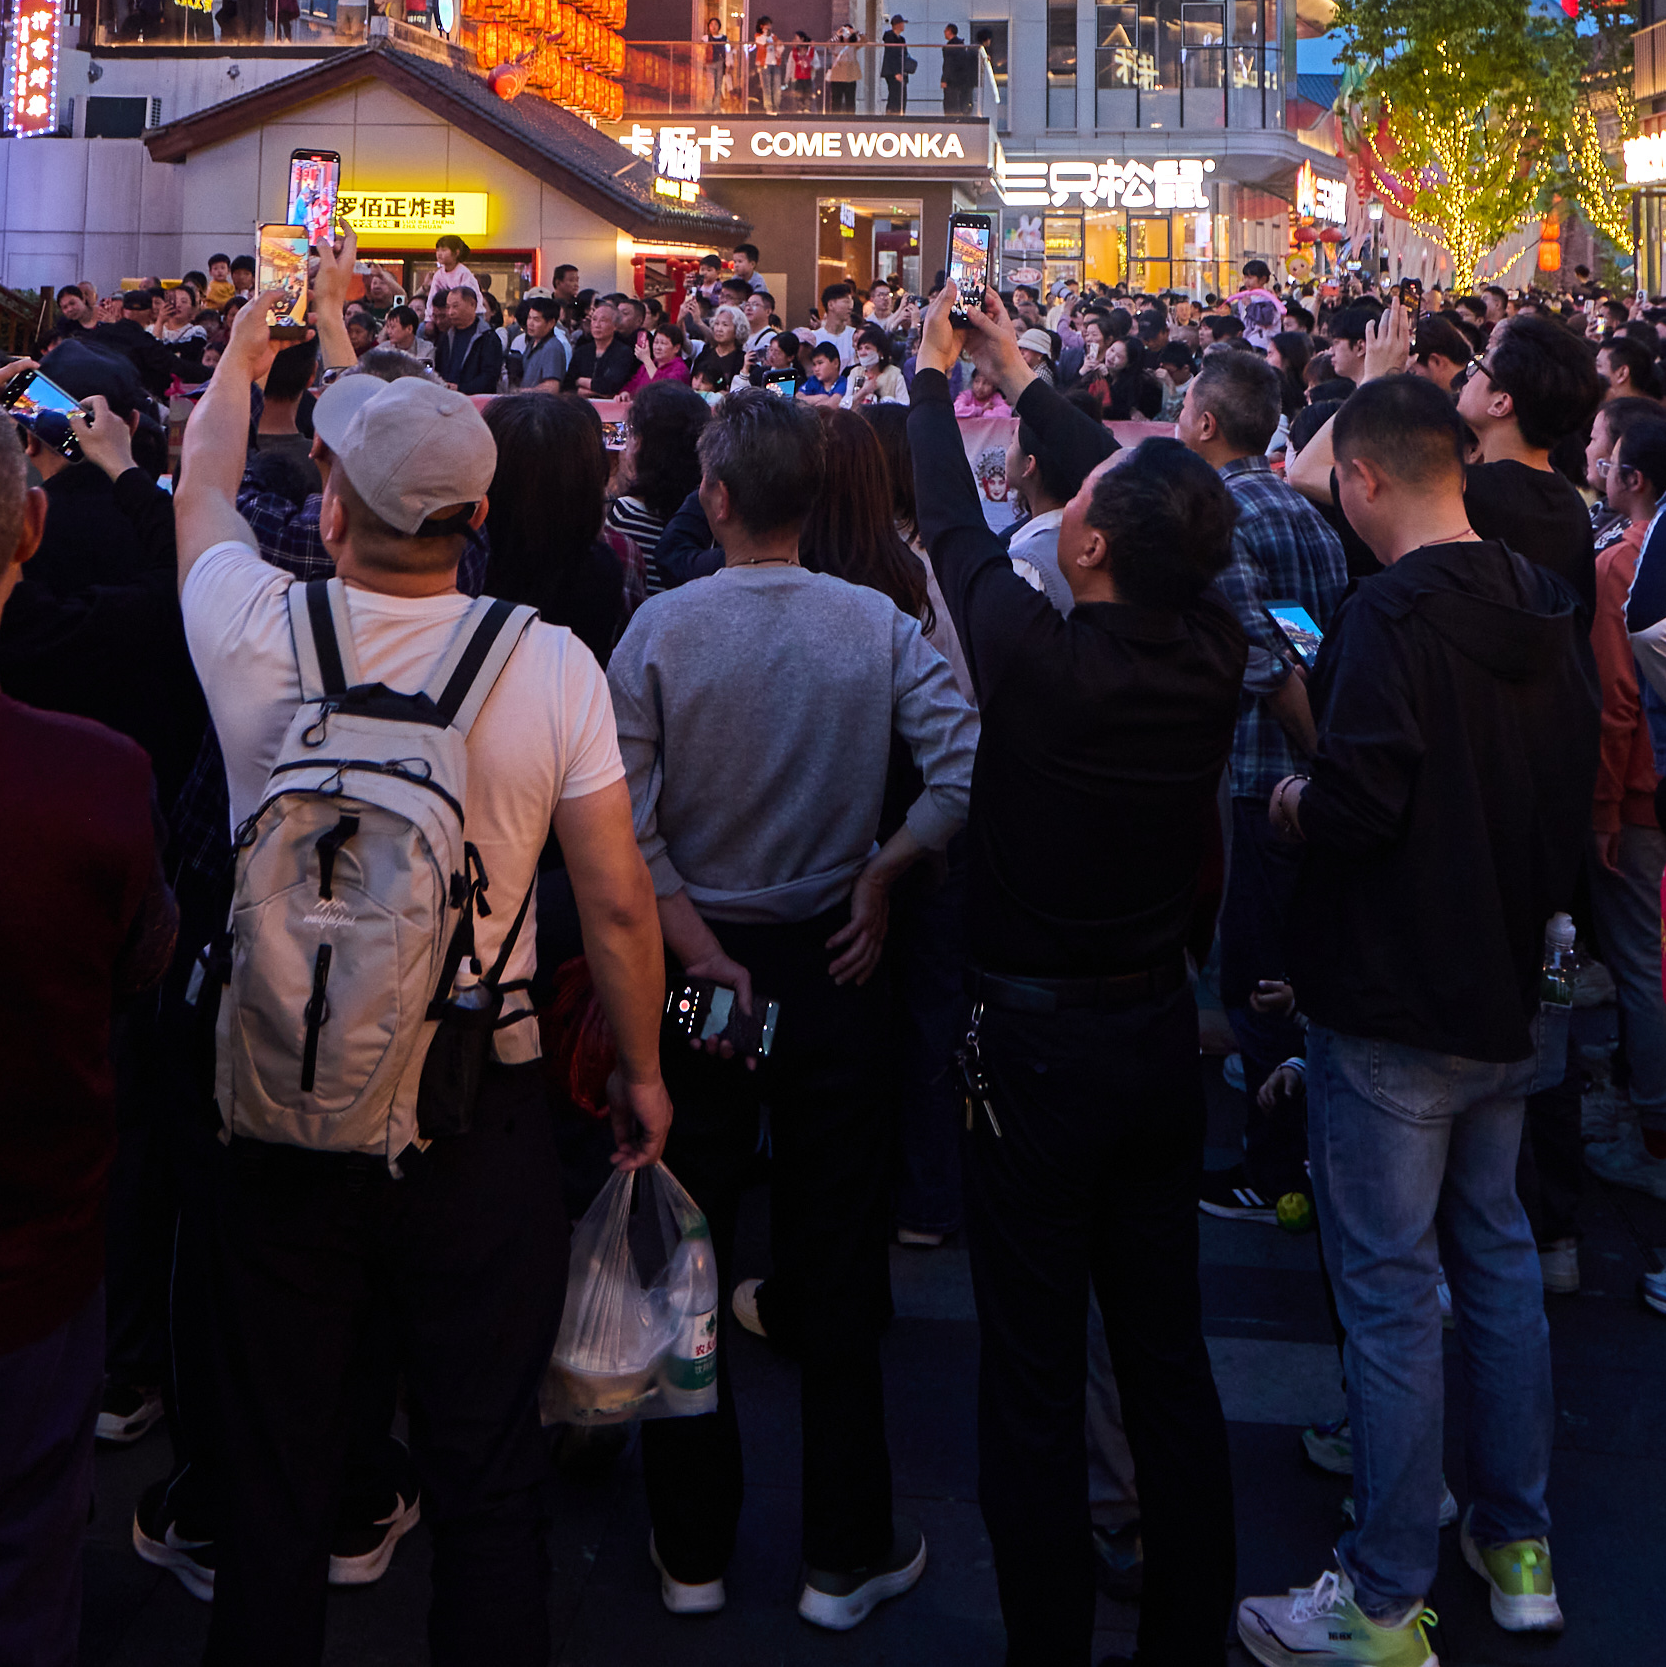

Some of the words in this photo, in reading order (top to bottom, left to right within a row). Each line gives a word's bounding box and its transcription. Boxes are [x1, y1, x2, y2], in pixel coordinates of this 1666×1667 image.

[750, 131, 842, 158] COME
[847, 132, 965, 159] WONKA
[1001, 159, 1211, 209] 三只松鼠
[336, 196, 455, 218] 罗佰正炸串
